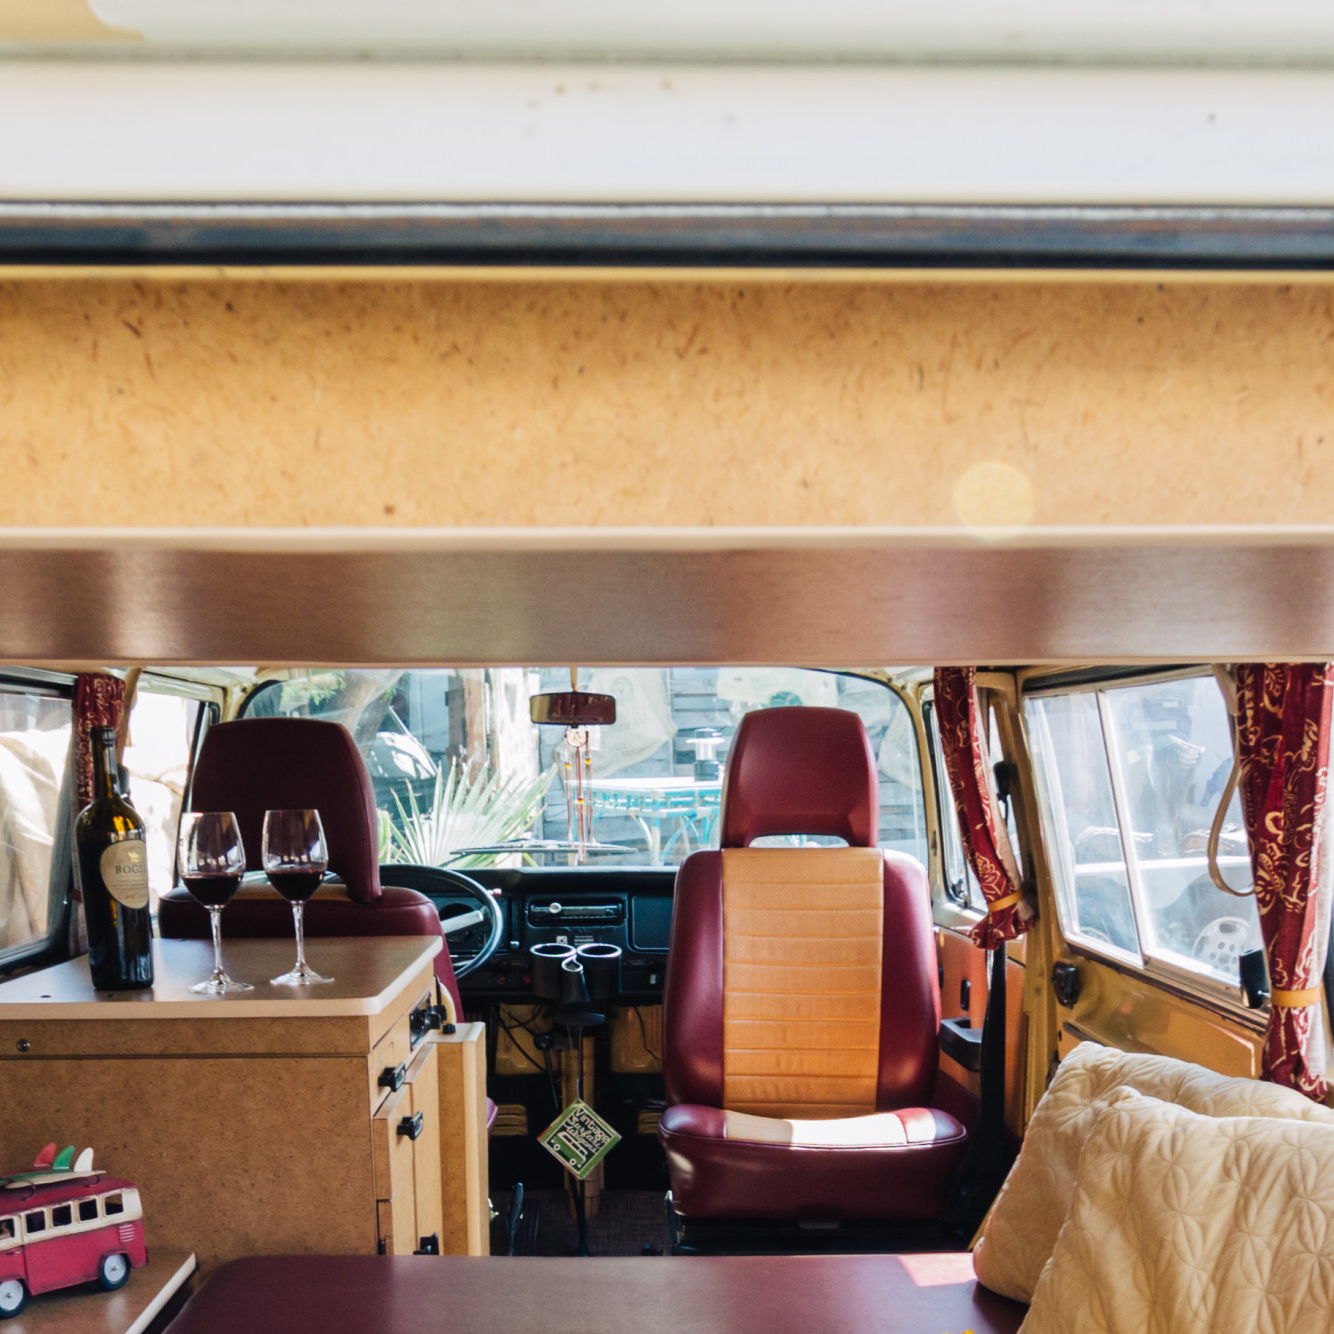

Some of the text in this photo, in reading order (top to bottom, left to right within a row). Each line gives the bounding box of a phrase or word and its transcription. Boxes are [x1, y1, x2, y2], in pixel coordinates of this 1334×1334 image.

[564, 1124, 597, 1154] Wagons
[565, 1115, 603, 1148] Surfari
[574, 1107, 610, 1143] Vintage
